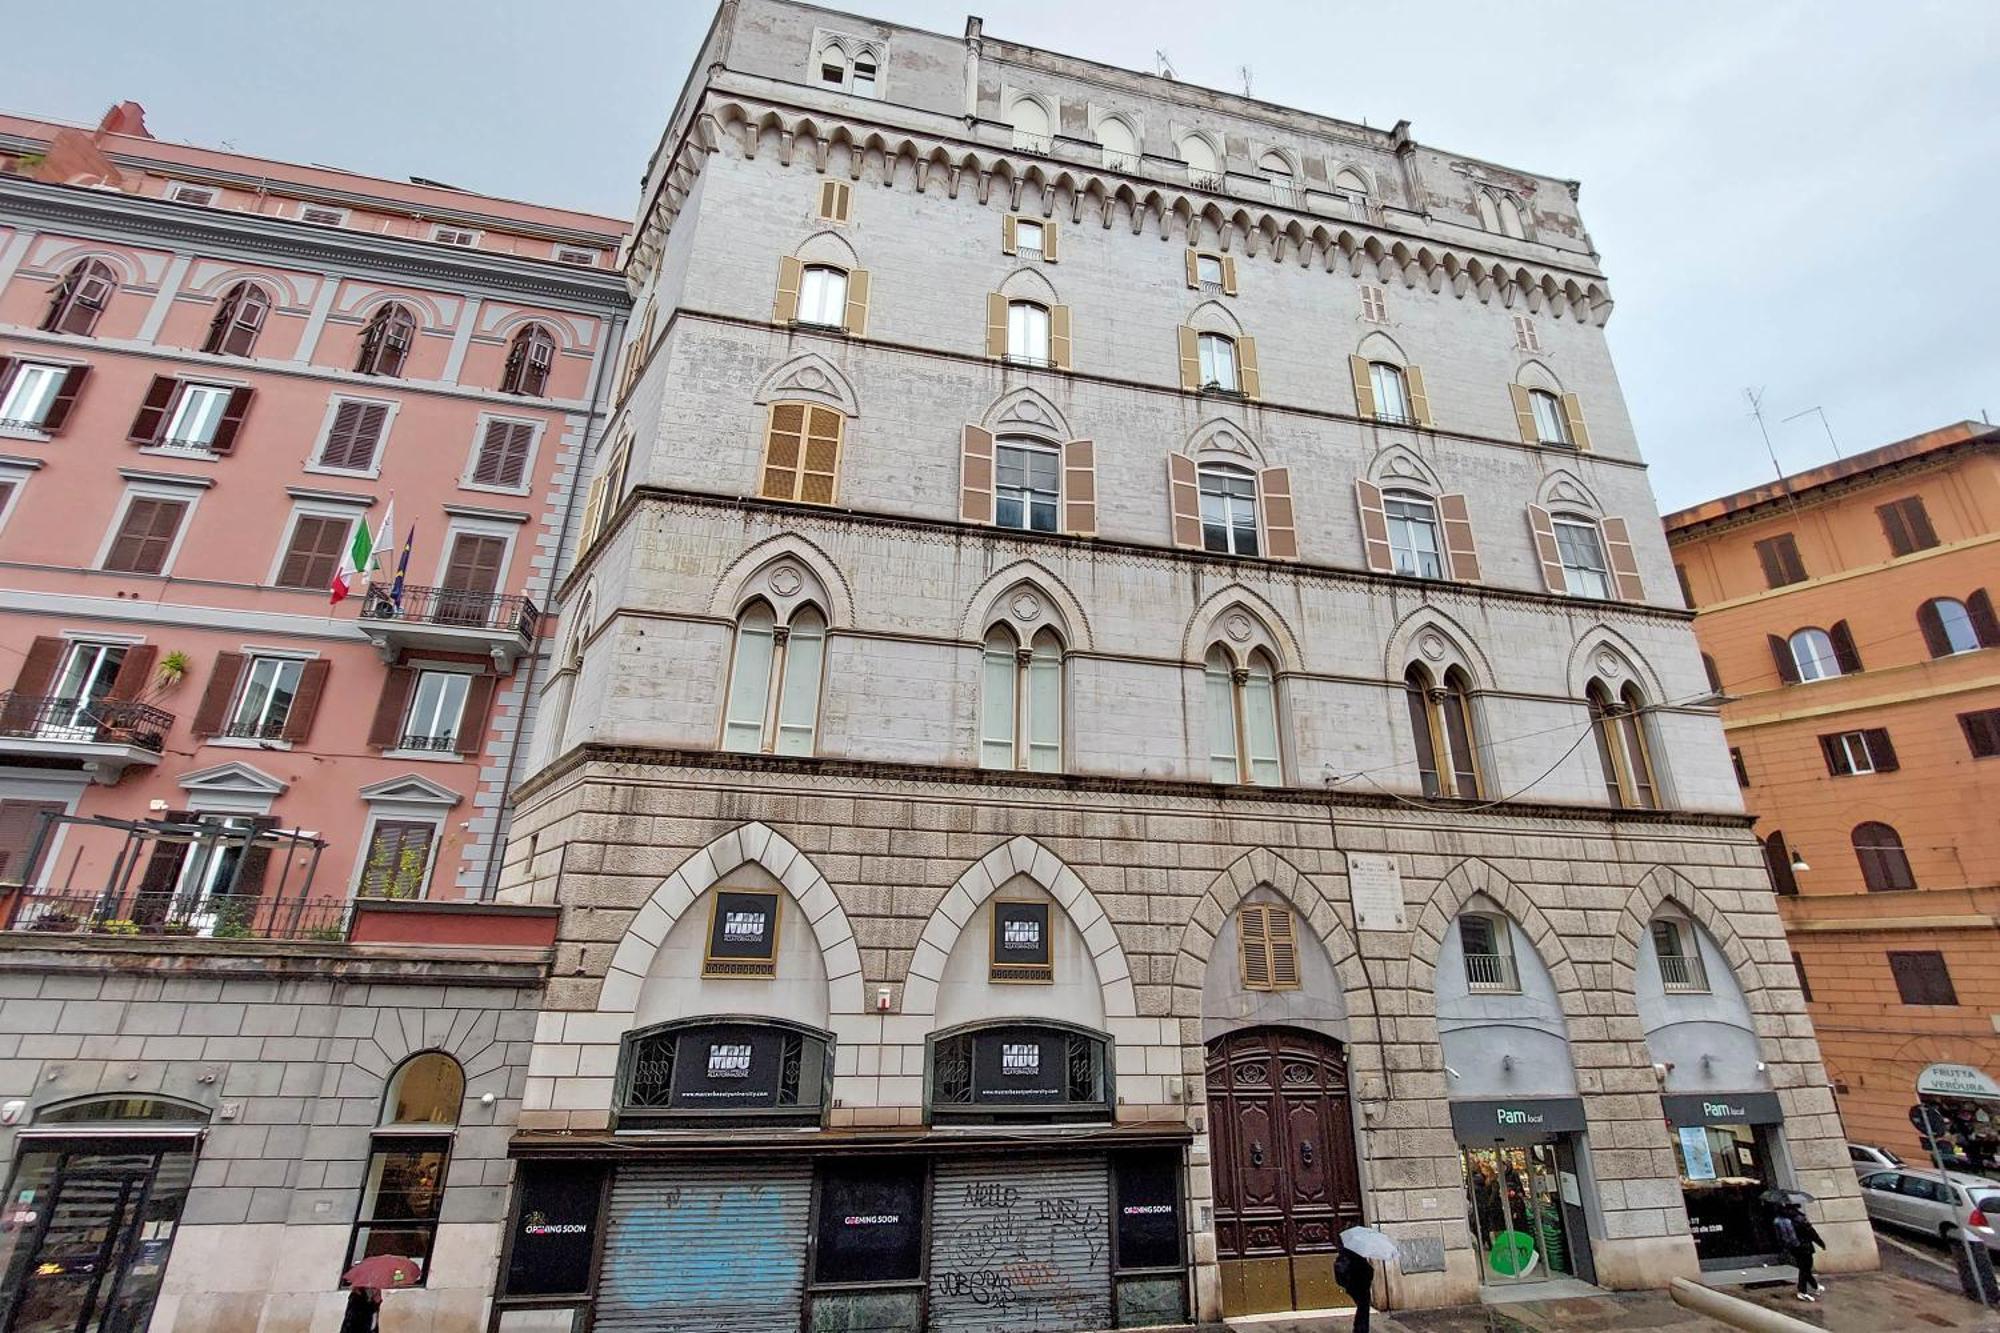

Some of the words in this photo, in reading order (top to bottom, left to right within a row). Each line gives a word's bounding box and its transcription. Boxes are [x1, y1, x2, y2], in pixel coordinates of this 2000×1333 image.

[1932, 1068, 1977, 1079] FRUTTA
[1931, 1080, 1986, 1092] VERDURA
[1703, 1102, 1730, 1116] Pam
[1497, 1109, 1526, 1124] Pam
[1527, 1114, 1544, 1123] local
[1153, 1205, 1172, 1213] SOON
[877, 1215, 899, 1224] SOON
[562, 1224, 587, 1233] SOON
